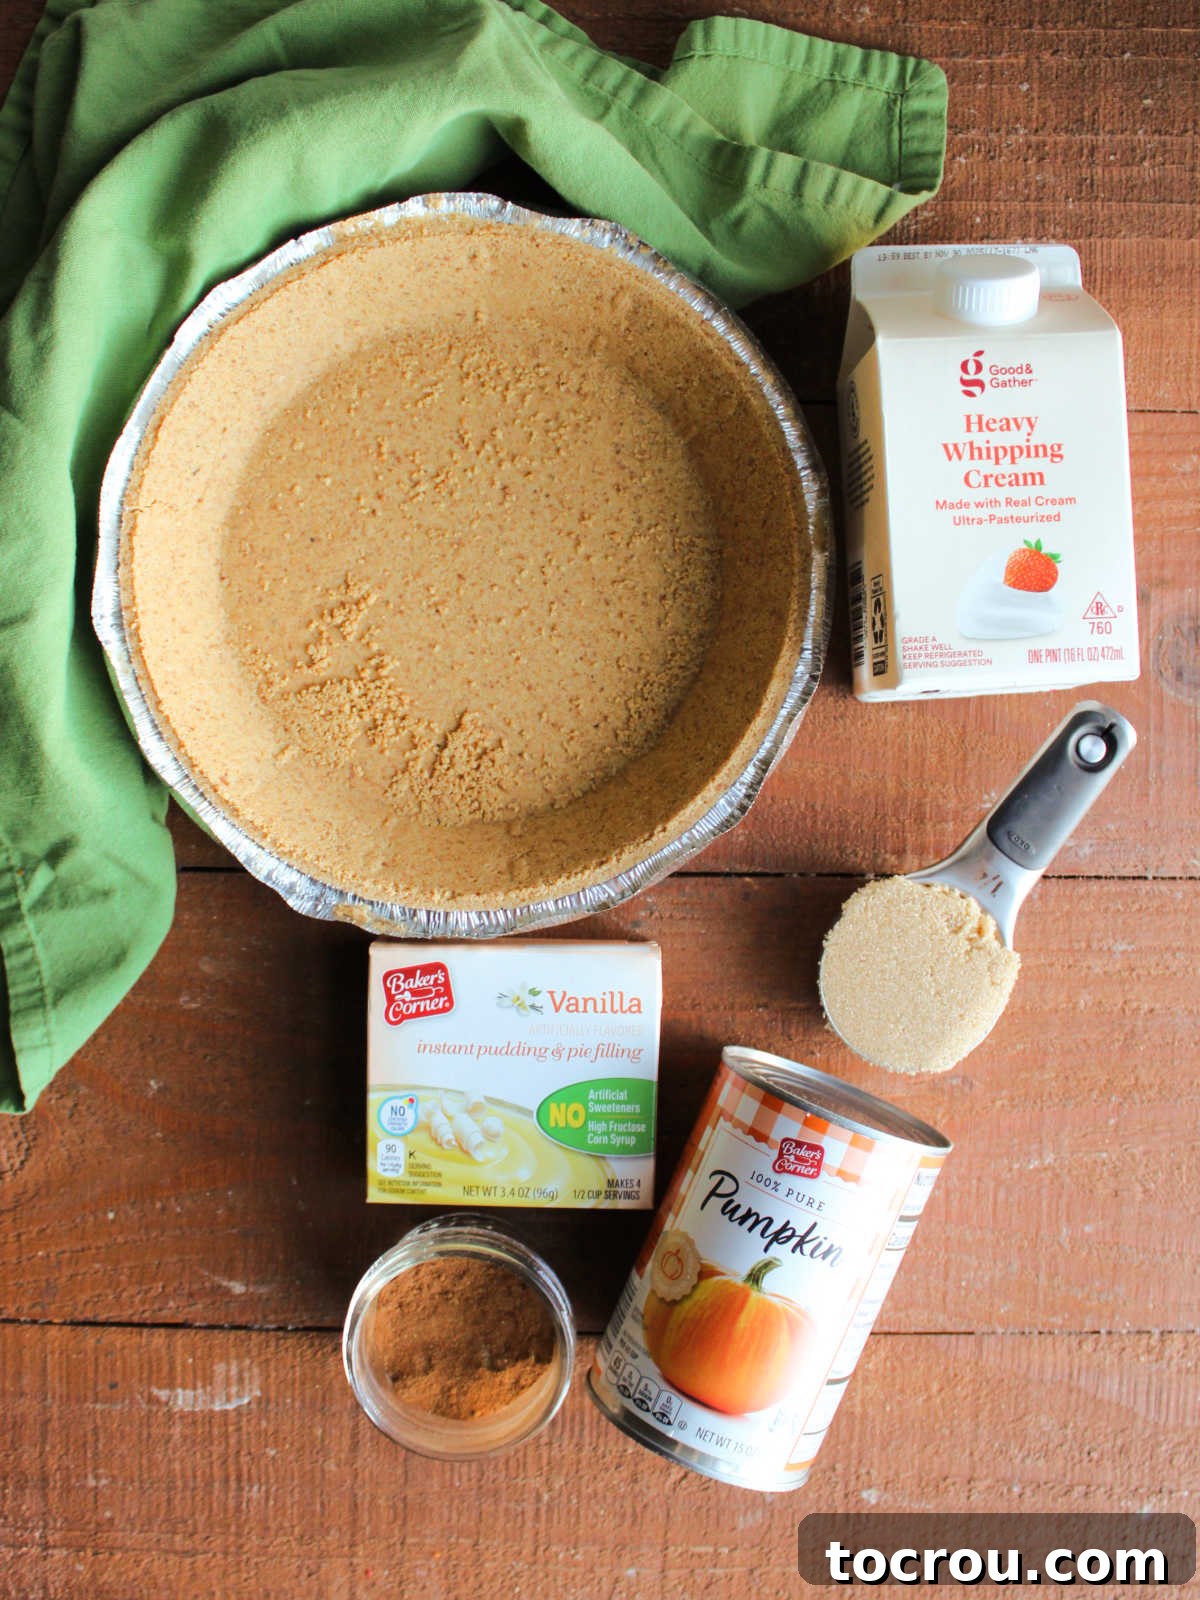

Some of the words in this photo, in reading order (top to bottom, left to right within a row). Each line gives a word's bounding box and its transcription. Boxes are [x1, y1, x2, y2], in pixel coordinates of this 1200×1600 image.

[989, 377, 1034, 389] Gather
[964, 414, 1039, 435] Heavy
[942, 433, 1064, 466] Whipping
[963, 469, 1046, 489] Cream
[936, 500, 970, 511] Made
[974, 498, 1001, 509] with
[1005, 496, 1031, 508] Real
[1034, 495, 1077, 507] Cream
[953, 512, 1061, 526] Ultra-Pasteurized
[1088, 621, 1112, 635] 760
[902, 636, 929, 644] GRADE
[932, 643, 952, 651] WELL
[924, 649, 984, 659] REFRIGERATED
[1028, 649, 1043, 664] ONE
[1045, 648, 1062, 663] PINT
[1076, 648, 1086, 662] FL
[903, 660, 938, 669] SERVING
[940, 657, 992, 667] SUGGESTION
[386, 968, 446, 995] Baker's
[547, 990, 643, 1014] Vanilla
[388, 997, 448, 1022] Corner
[416, 1039, 474, 1056] instant
[475, 1040, 551, 1061] pudding
[551, 1043, 566, 1060] &
[566, 1044, 592, 1061] pie
[590, 1042, 644, 1063] filling
[588, 1089, 628, 1100] Artificial
[390, 1105, 406, 1117] NO
[588, 1102, 641, 1113] Sweeteners
[549, 1102, 586, 1129] NO
[587, 1121, 608, 1133] High
[609, 1121, 646, 1133] Fructose
[587, 1133, 608, 1145] Corn
[610, 1134, 636, 1147] Syrup
[385, 1144, 397, 1153] 90
[781, 1140, 823, 1161] Baker's
[774, 1158, 818, 1176] Corner
[607, 1178, 633, 1189] MAKES
[463, 1186, 480, 1197] NET
[482, 1186, 498, 1197] WT
[501, 1186, 515, 1198] 3.4
[518, 1187, 530, 1199] OZ
[532, 1187, 559, 1200] (96g)
[573, 1189, 586, 1200] 1/2
[587, 1190, 603, 1200] CUP
[604, 1190, 641, 1201] SERVINGS
[749, 1170, 781, 1193] 100%
[786, 1187, 826, 1212] PURE
[700, 1169, 844, 1268] Pumpkin
[695, 1426, 715, 1443] NET
[715, 1434, 732, 1449] WT
